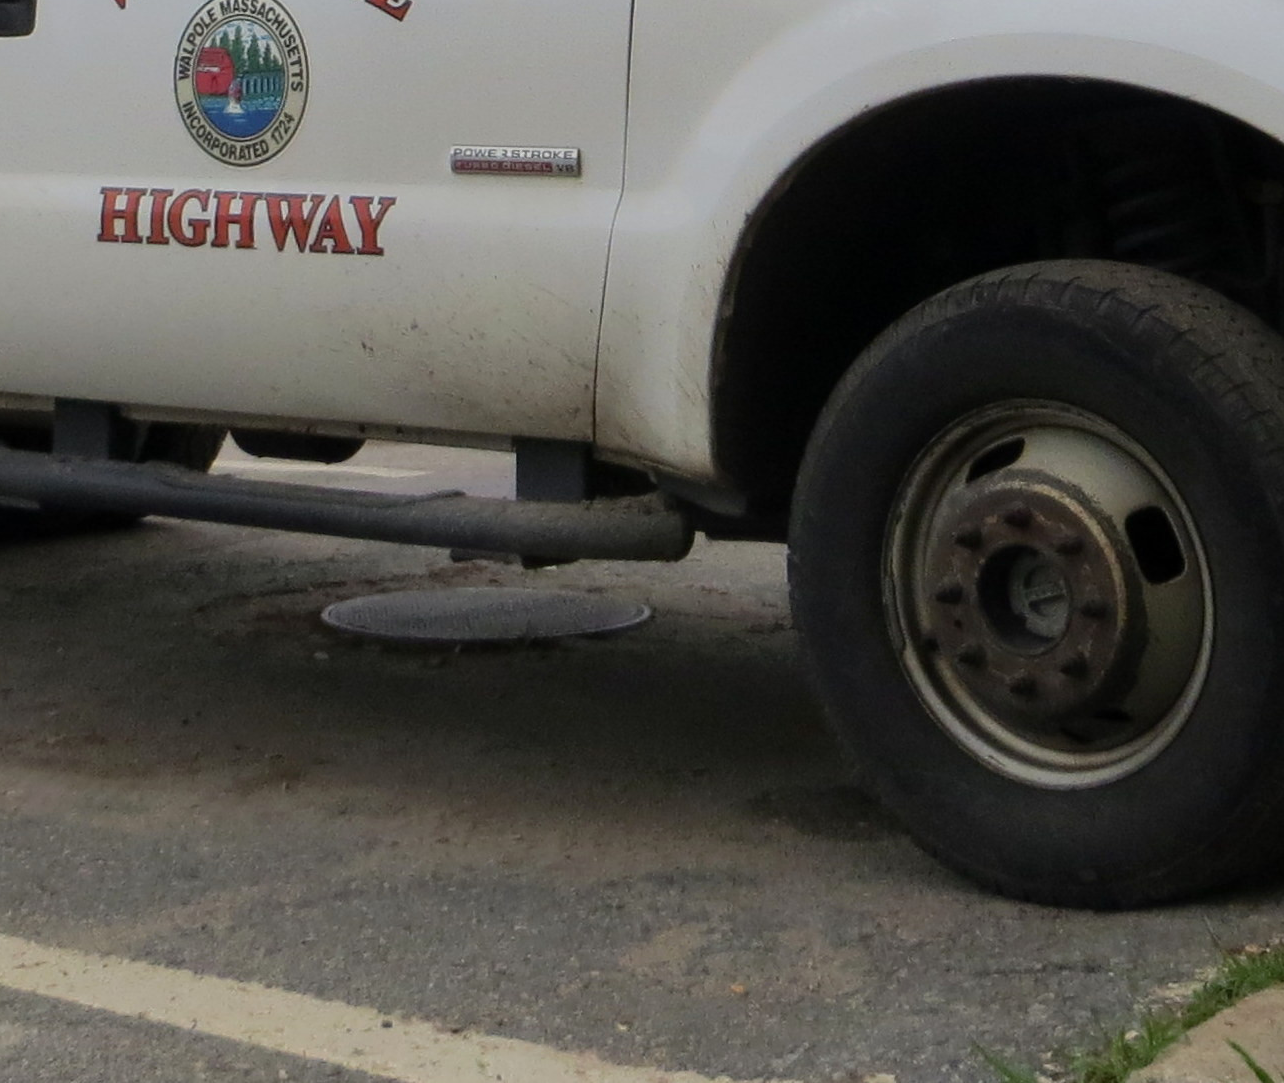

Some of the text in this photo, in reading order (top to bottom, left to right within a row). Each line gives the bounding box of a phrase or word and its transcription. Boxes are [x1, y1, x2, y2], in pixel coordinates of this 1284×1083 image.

[178, 6, 217, 81] WALPOLE
[182, 101, 295, 161] INCORPORATED 1724
[97, 186, 397, 256] HIGHWAY
